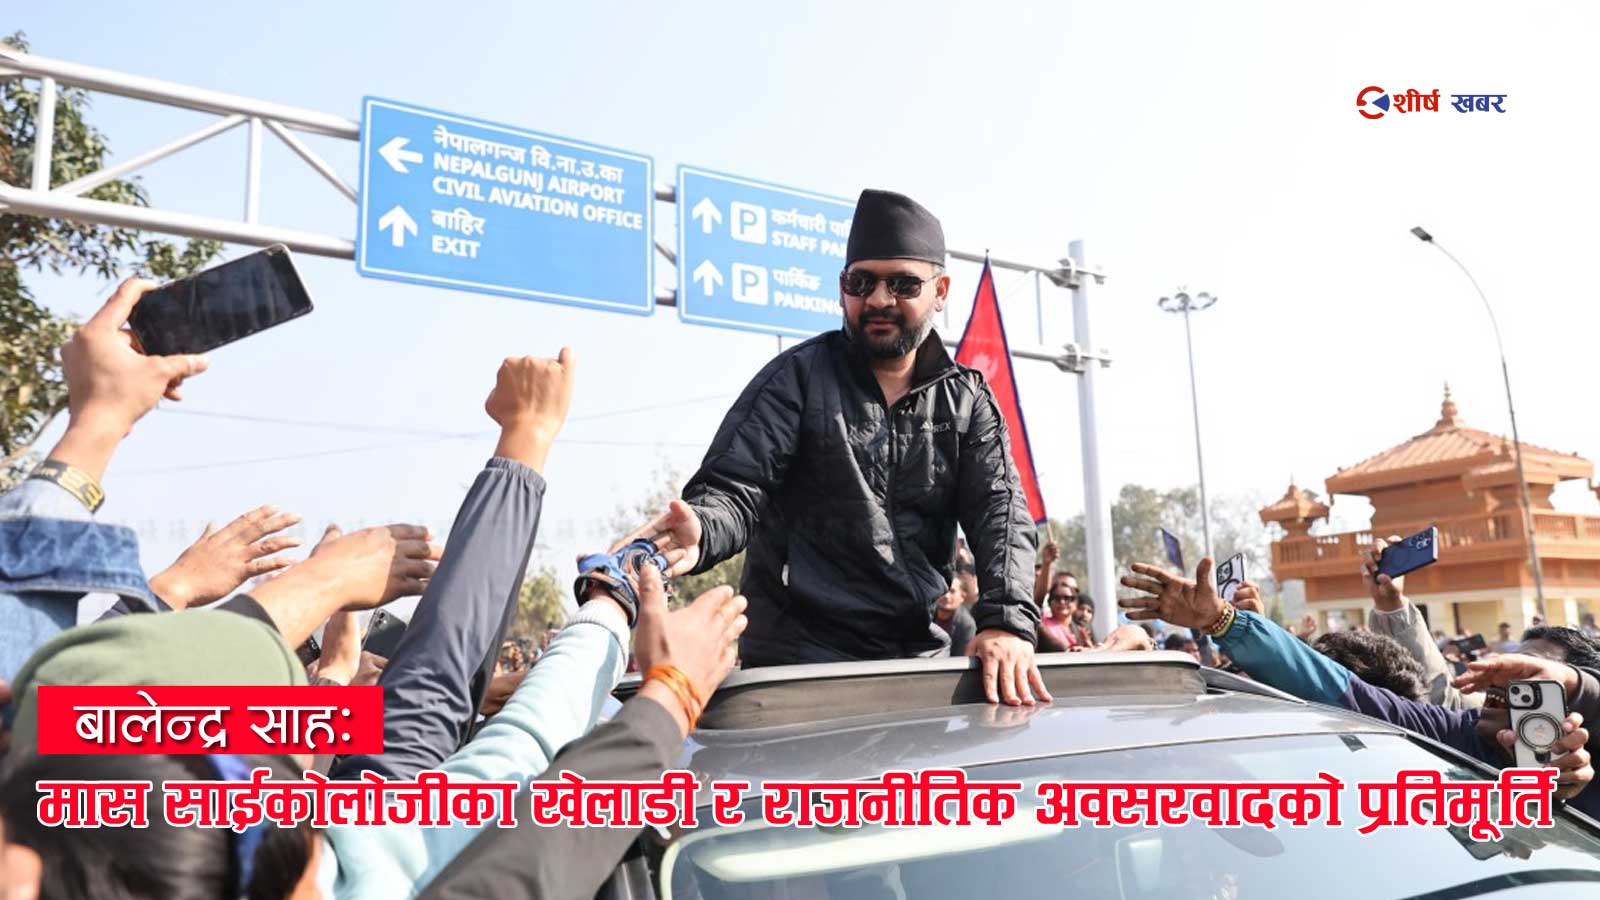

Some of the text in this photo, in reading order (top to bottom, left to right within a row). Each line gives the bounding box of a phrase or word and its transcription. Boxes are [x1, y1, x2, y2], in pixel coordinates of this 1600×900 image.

[434, 153, 623, 203] NEPALGUNJ AIRPORT
[433, 176, 642, 229] CIVIL AVIATION OFFICE
[432, 208, 485, 234] बाहिर
[432, 235, 479, 257] EXIT
[773, 231, 816, 250] STAFF
